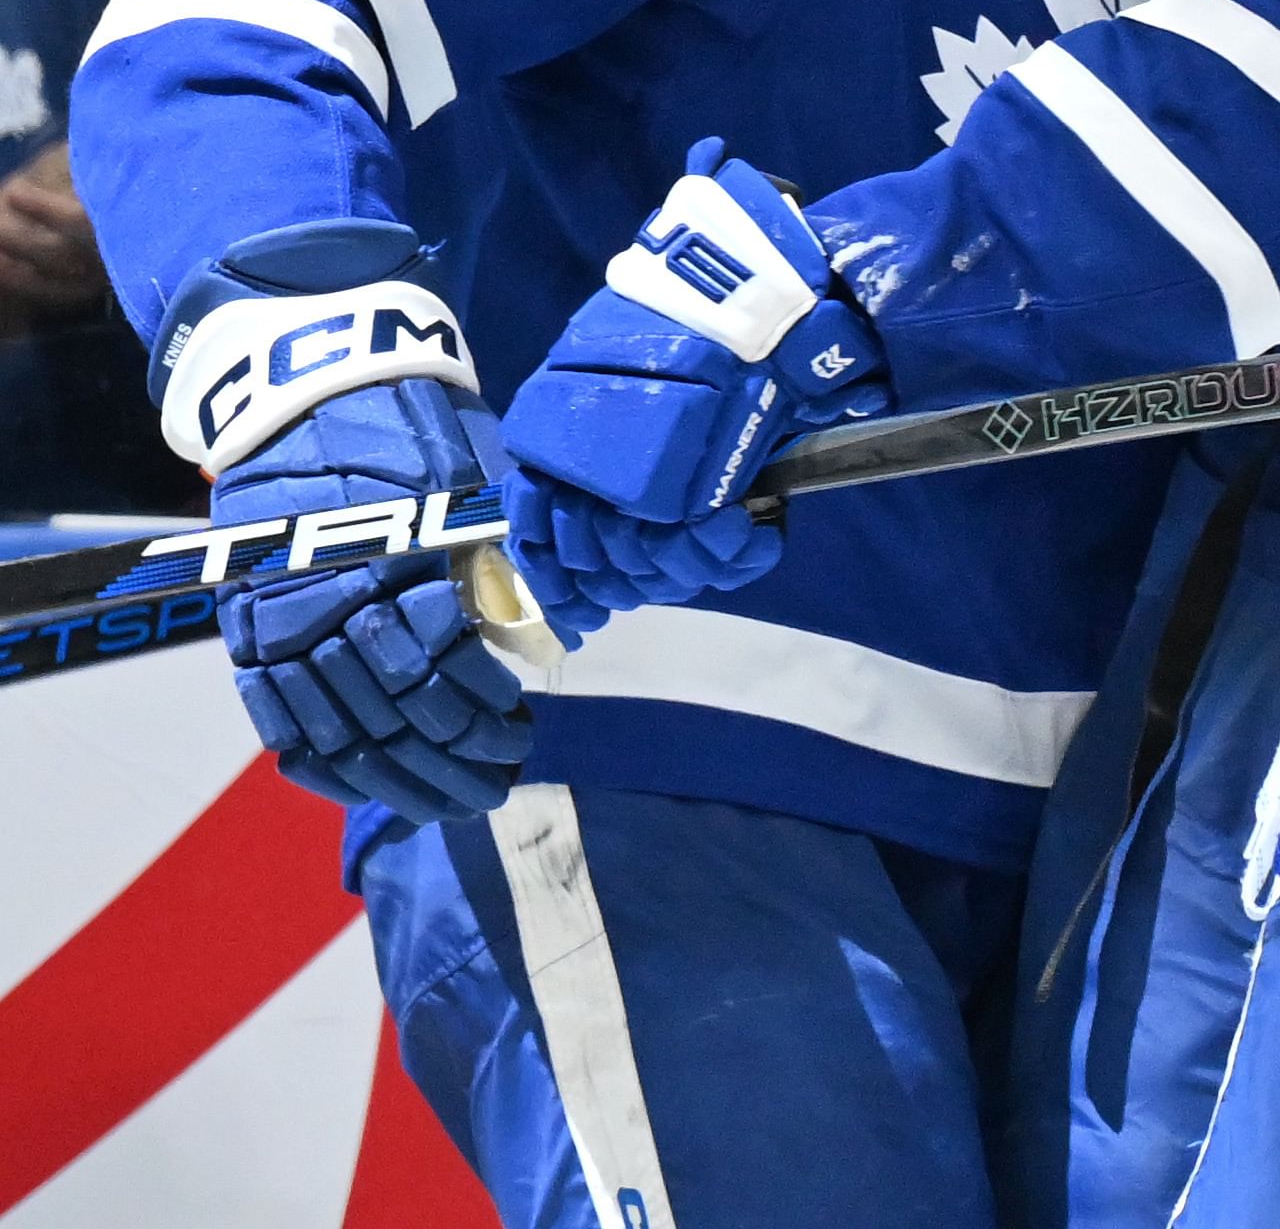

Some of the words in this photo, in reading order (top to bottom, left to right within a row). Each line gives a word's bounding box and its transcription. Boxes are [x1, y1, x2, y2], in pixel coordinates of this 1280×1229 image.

[161, 322, 193, 370] KNIES
[199, 309, 464, 450] CCM
[709, 412, 763, 508] MARNER
